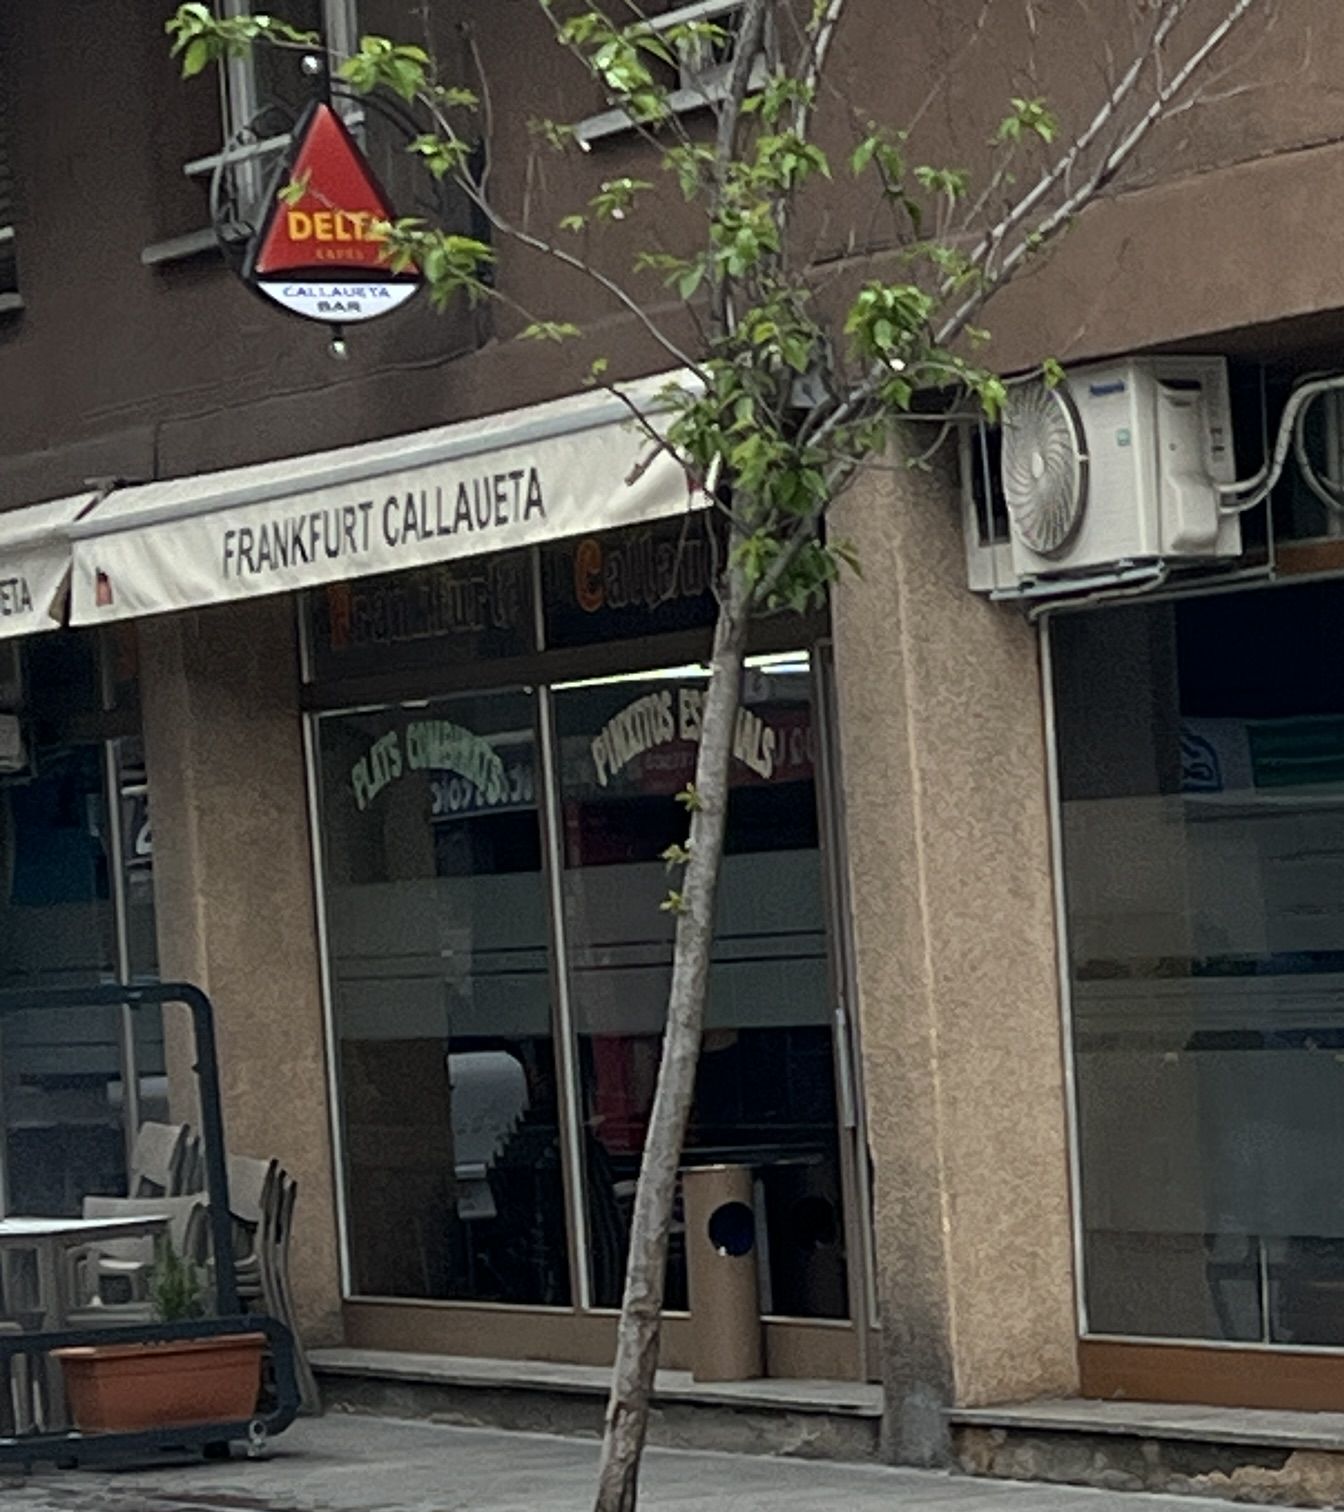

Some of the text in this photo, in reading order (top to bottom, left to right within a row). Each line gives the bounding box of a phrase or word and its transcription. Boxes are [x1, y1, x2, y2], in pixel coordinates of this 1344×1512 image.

[316, 301, 362, 313] BAR
[222, 466, 547, 580] FRANKFURT CALLAUETA
